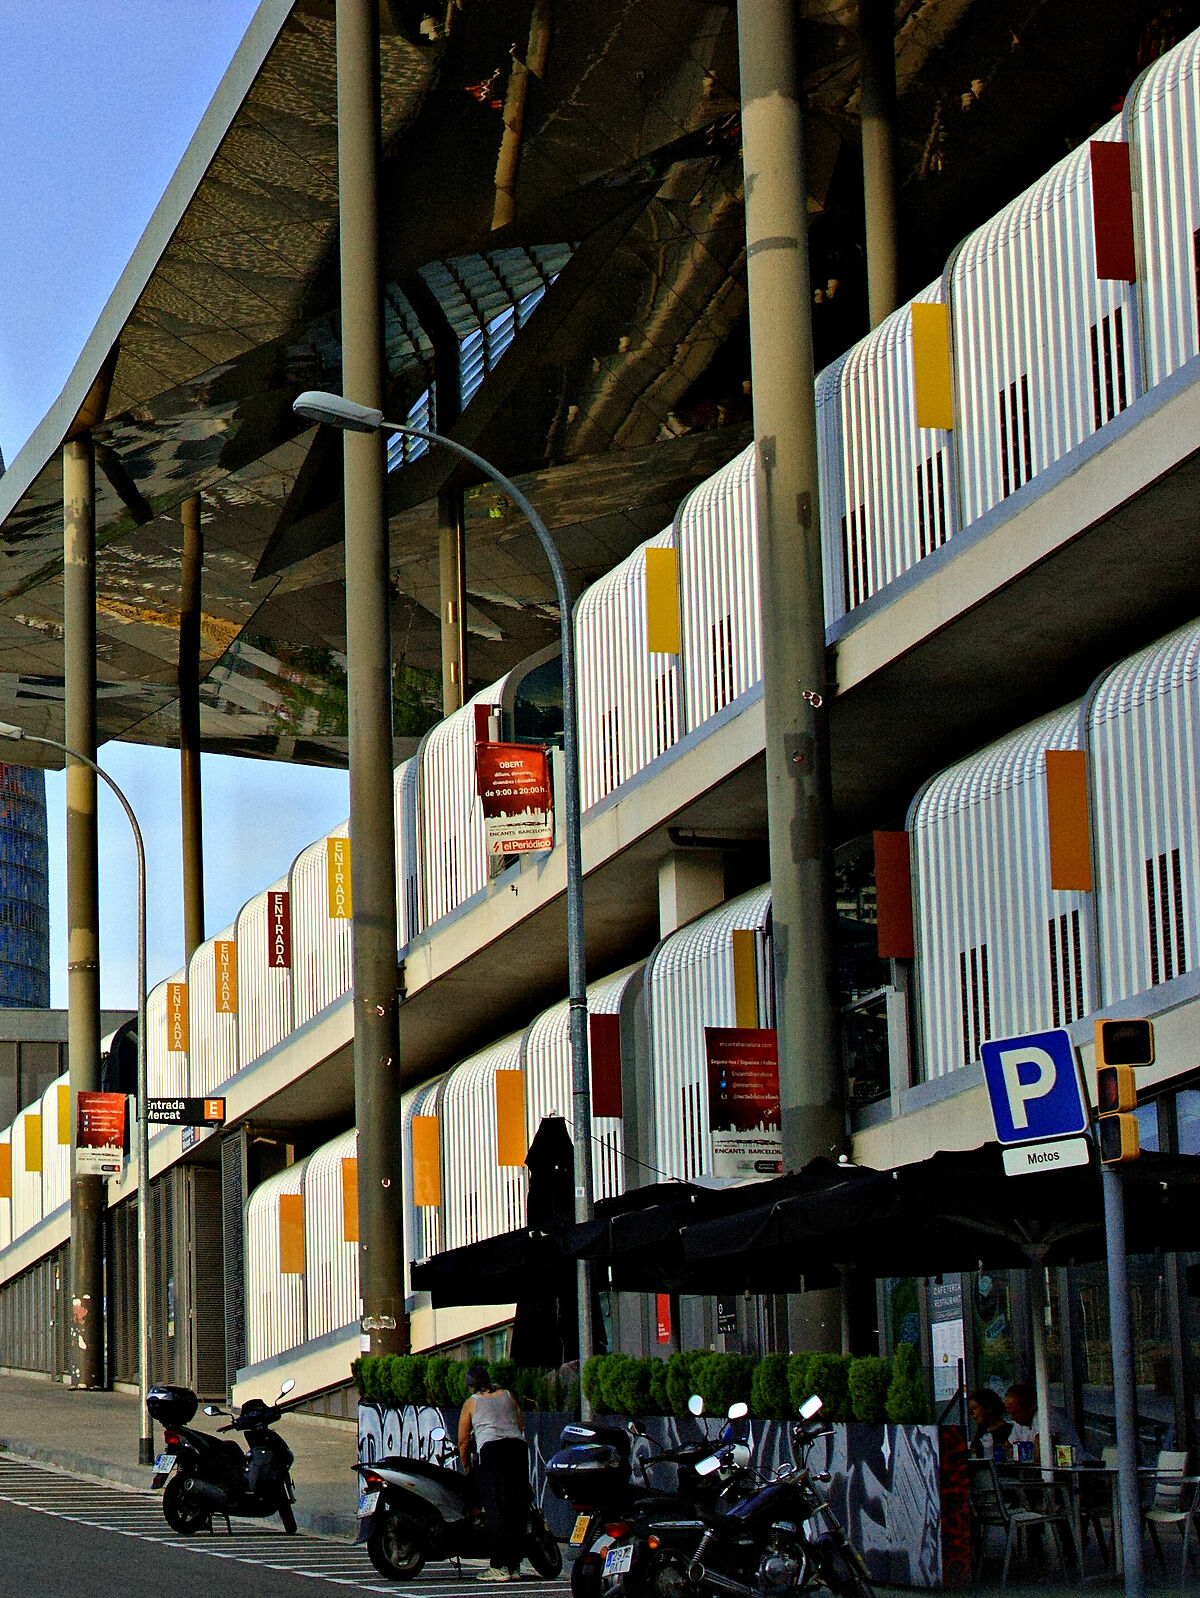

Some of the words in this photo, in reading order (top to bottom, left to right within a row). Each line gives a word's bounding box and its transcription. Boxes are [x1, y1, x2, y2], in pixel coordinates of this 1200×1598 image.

[495, 788, 512, 796] 9:00
[519, 786, 539, 795] 20:00
[499, 760, 524, 769] OBERT
[334, 841, 345, 916] ENTRADA
[274, 894, 285, 965] ENTRADA
[221, 943, 230, 1010] ENTRADA
[173, 985, 182, 1049] ENTRADA
[209, 1101, 218, 1115] E
[1000, 1046, 1057, 1129] P
[1027, 1150, 1060, 1165] Motos
